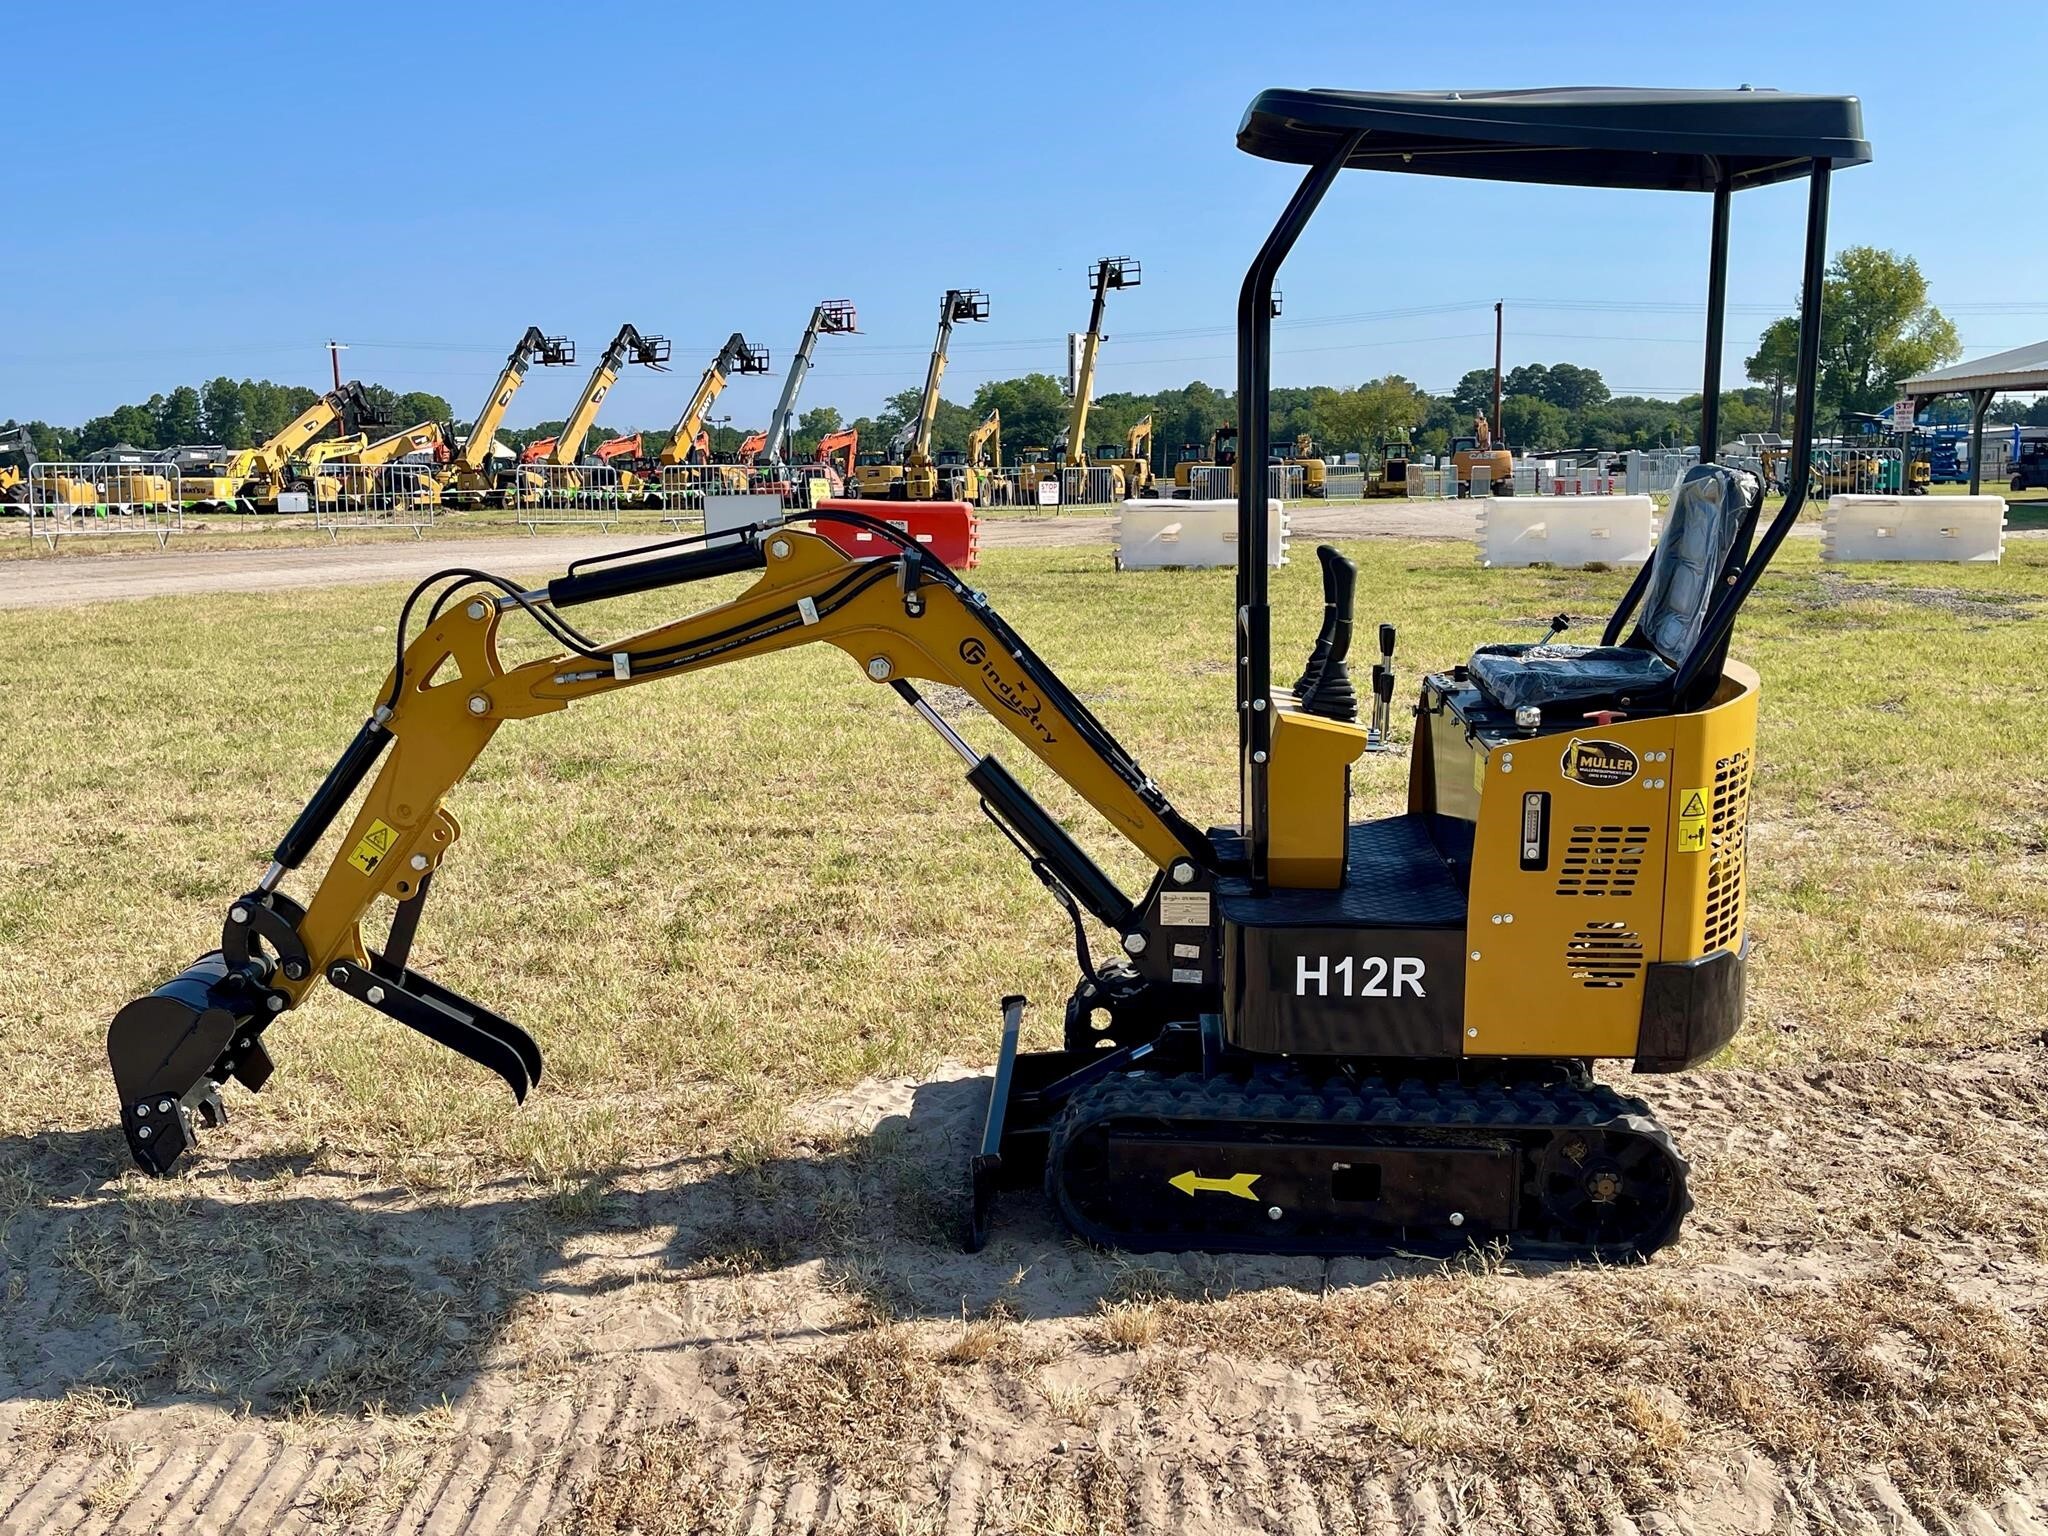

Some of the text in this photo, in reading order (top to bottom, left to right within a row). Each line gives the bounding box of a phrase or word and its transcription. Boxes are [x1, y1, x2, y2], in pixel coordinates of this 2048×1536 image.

[1468, 452, 1497, 460] CASE
[1041, 482, 1058, 490] STOP
[1580, 756, 1633, 771] MULLER
[1296, 956, 1426, 997] H12R
